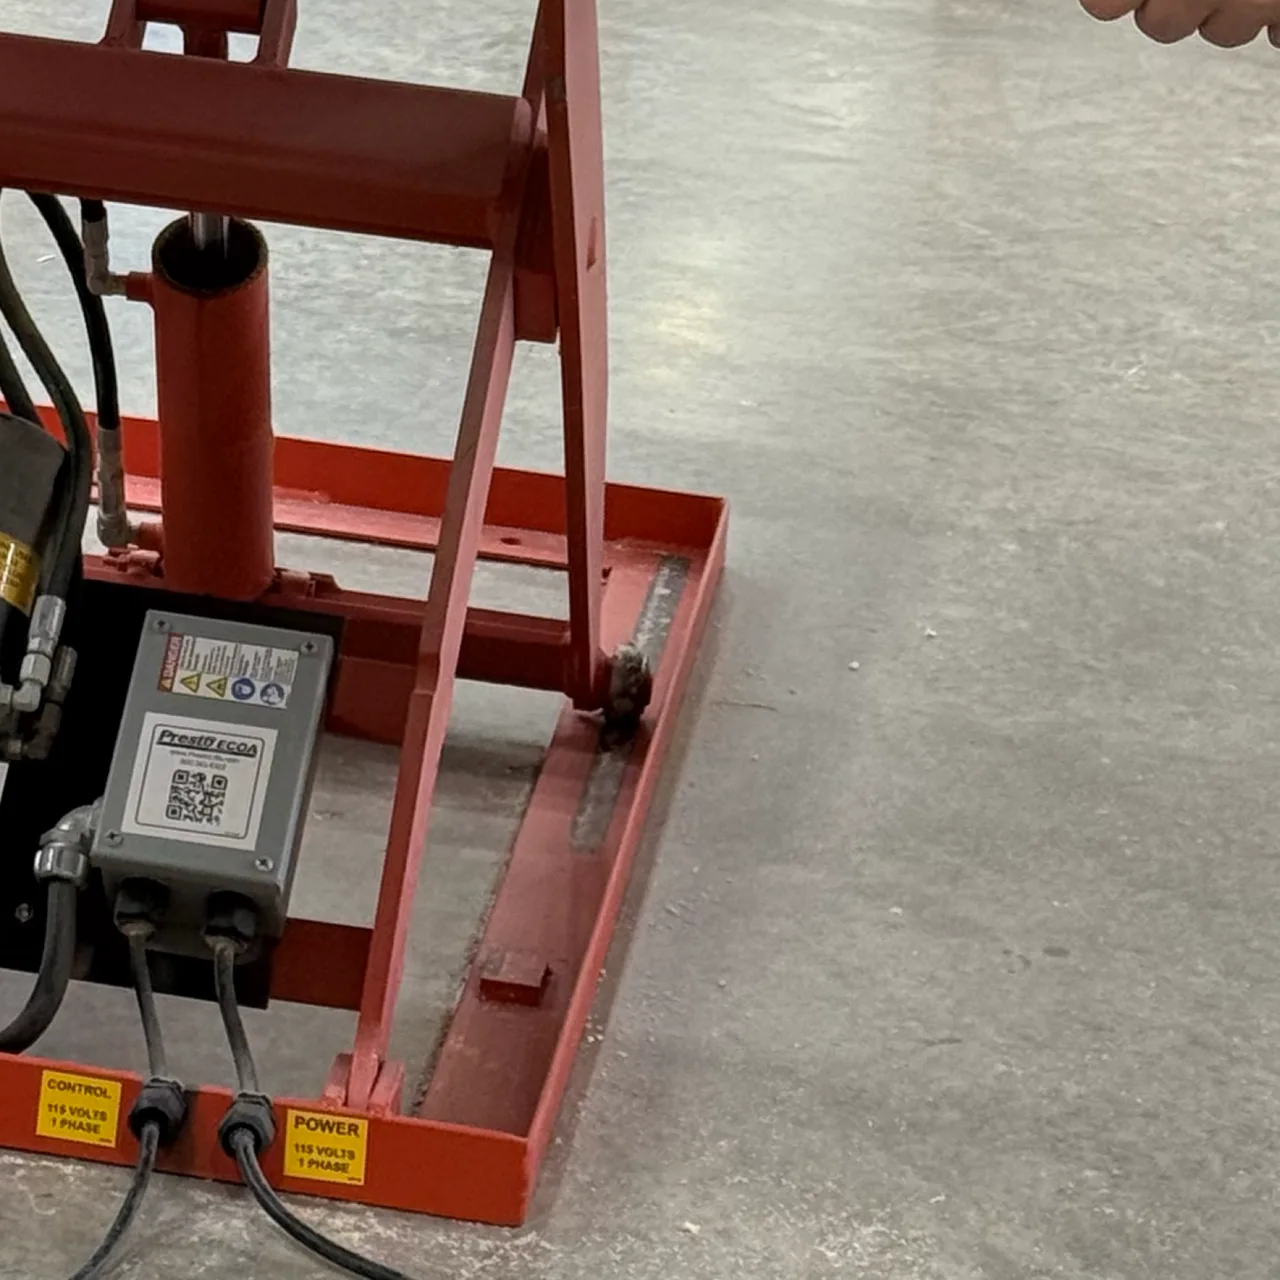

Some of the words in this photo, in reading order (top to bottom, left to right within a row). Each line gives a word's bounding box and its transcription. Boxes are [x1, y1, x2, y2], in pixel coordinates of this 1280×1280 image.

[217, 739, 258, 755] ECOA
[47, 1078, 112, 1099] CONTROL
[47, 1103, 67, 1115] 115
[69, 1106, 108, 1122] VOLTS
[60, 1118, 101, 1134] PHASE
[294, 1115, 360, 1138] POWER
[294, 1142, 314, 1154] 115
[316, 1145, 356, 1161] VOLTS
[307, 1158, 350, 1174] PHASE
